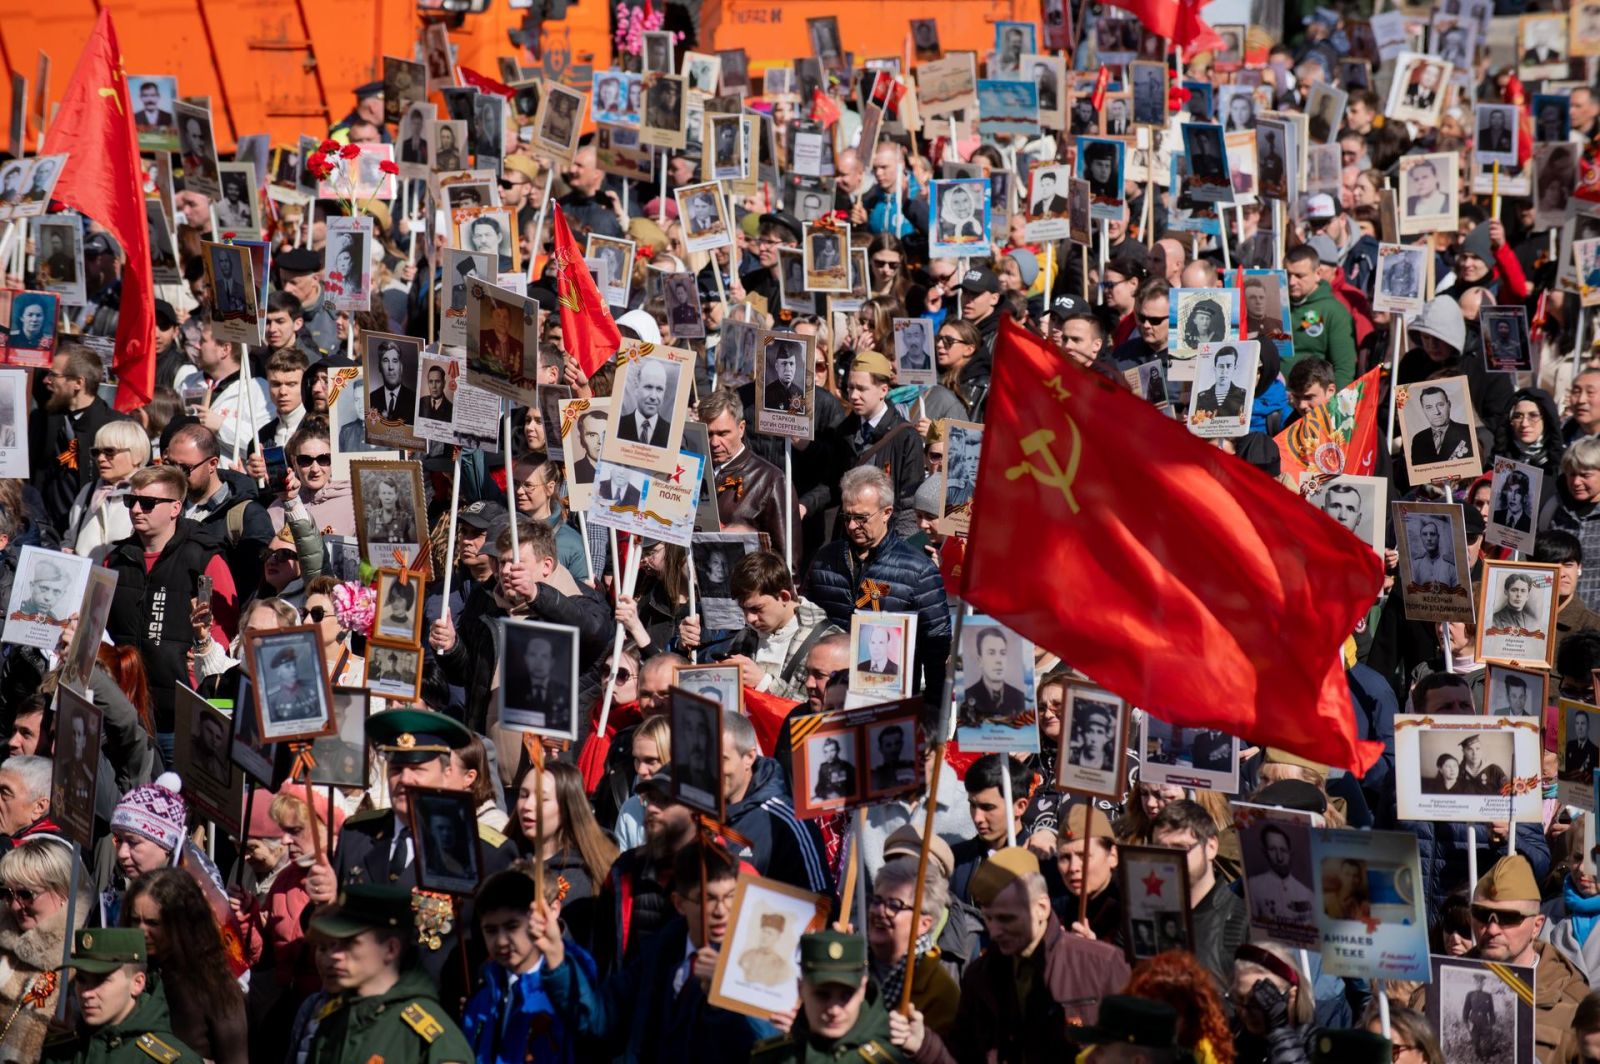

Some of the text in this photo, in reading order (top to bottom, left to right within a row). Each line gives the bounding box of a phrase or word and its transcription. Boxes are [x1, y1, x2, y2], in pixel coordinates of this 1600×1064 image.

[771, 414, 797, 424] СТАРКОВ
[659, 490, 682, 502] ПОЛК
[1334, 947, 1366, 959] ТЕКЕ
